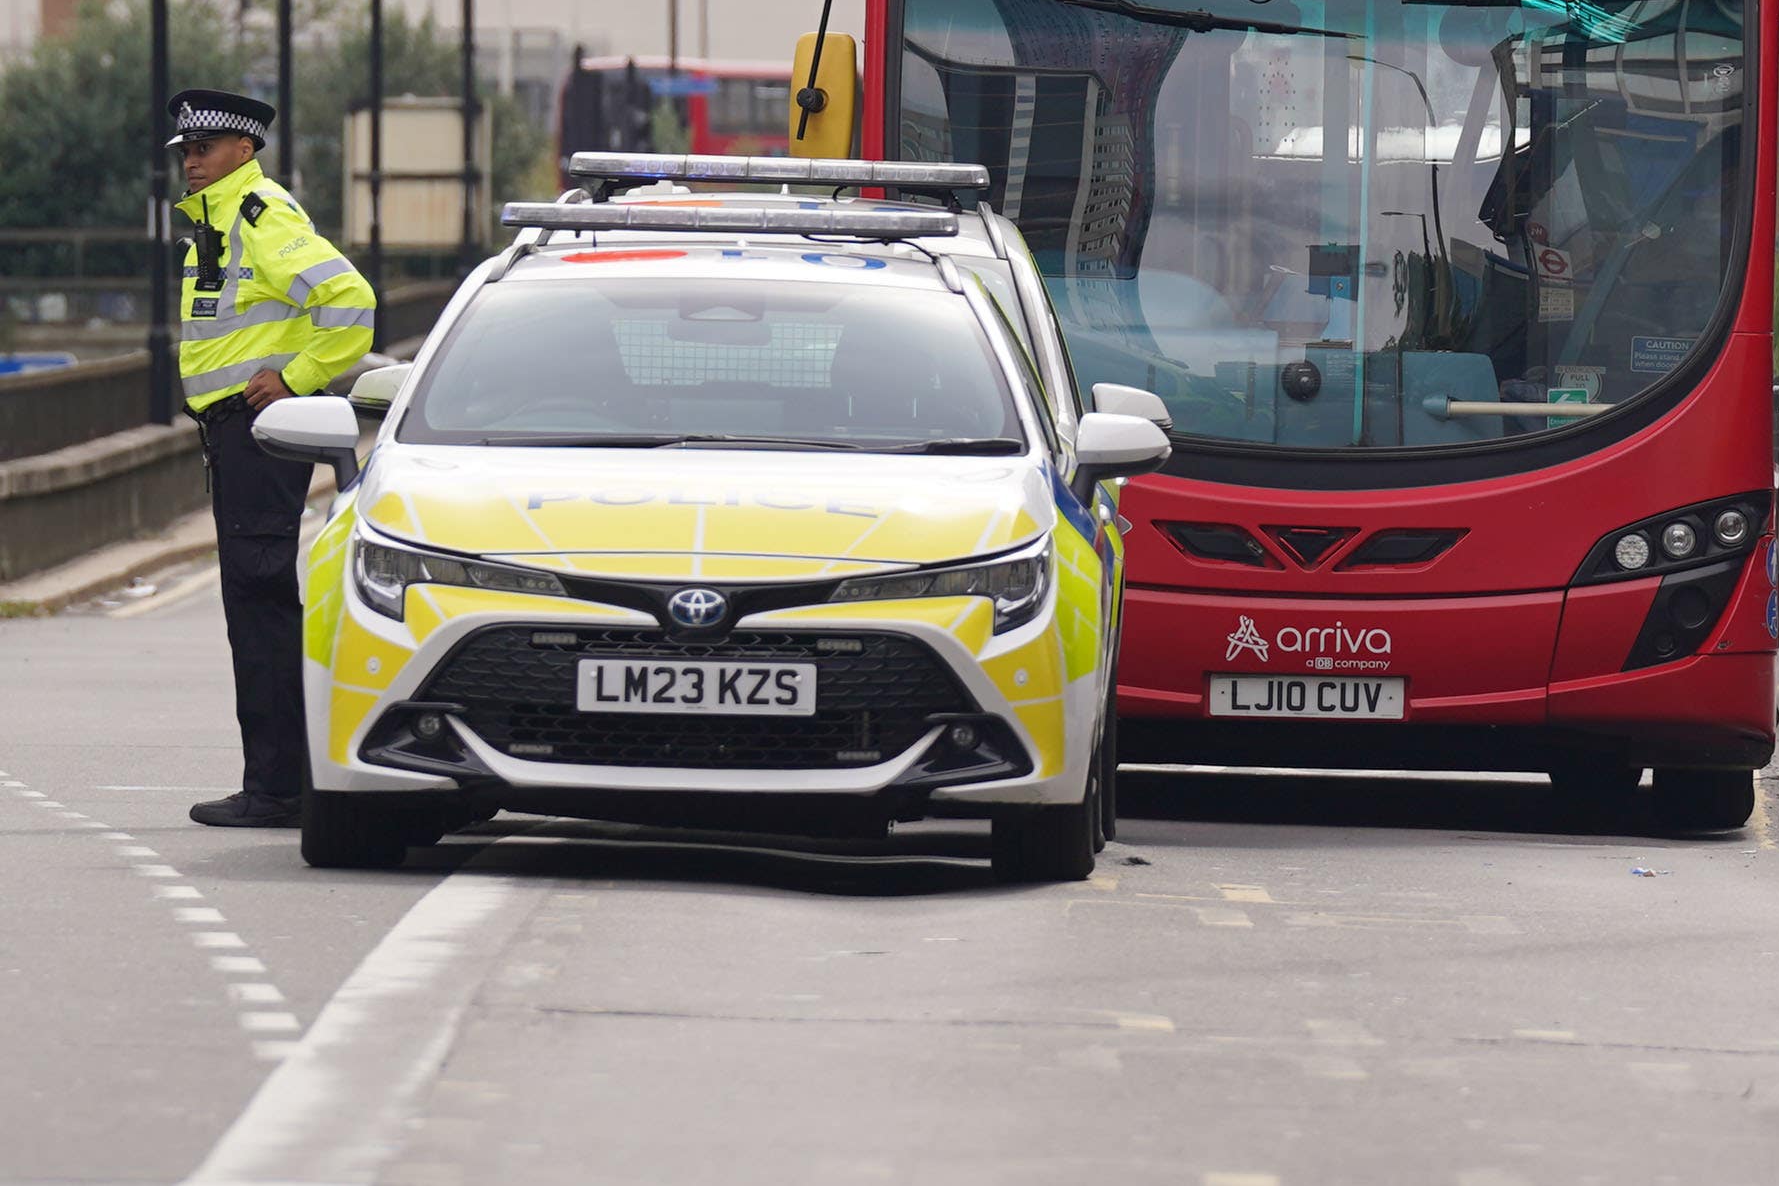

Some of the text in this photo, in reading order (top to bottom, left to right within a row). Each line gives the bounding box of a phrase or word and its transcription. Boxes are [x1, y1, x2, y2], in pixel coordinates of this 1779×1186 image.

[278, 236, 309, 259] POLICE
[1646, 340, 1690, 351] CAUTION
[1276, 620, 1392, 655] arriva
[1305, 658, 1392, 671] a DB company
[595, 664, 800, 706] LM23 KZS
[1231, 680, 1383, 713] LJ10 CUV
